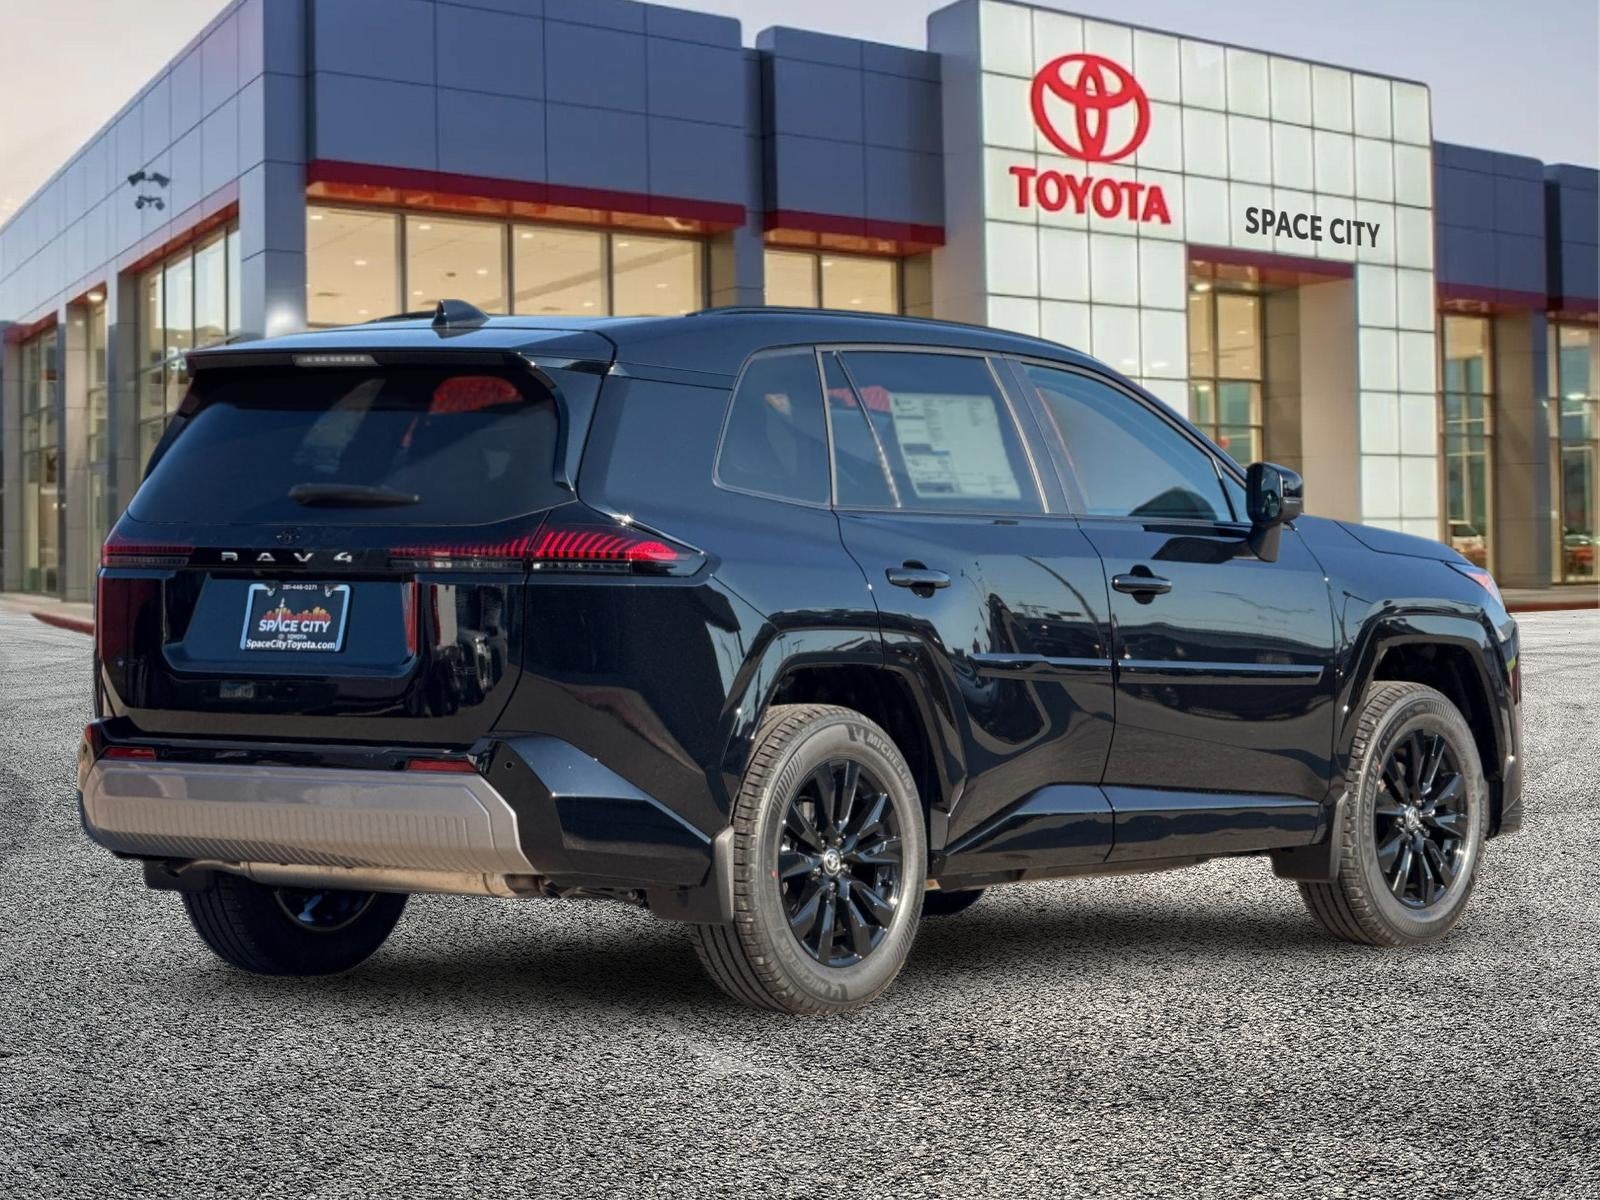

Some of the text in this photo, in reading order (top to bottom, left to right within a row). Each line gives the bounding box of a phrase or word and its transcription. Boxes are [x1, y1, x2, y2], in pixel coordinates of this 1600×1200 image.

[1009, 166, 1171, 224] TOYOTA
[1245, 206, 1380, 248] SPACE CITY
[221, 551, 352, 563] RAV4
[258, 619, 331, 633] SPACE CITY
[287, 633, 307, 641] TOYOTA
[246, 638, 336, 651] SpaceCityToyota.com
[866, 731, 914, 791] MICHELIN
[1363, 754, 1381, 837] MICHELIN
